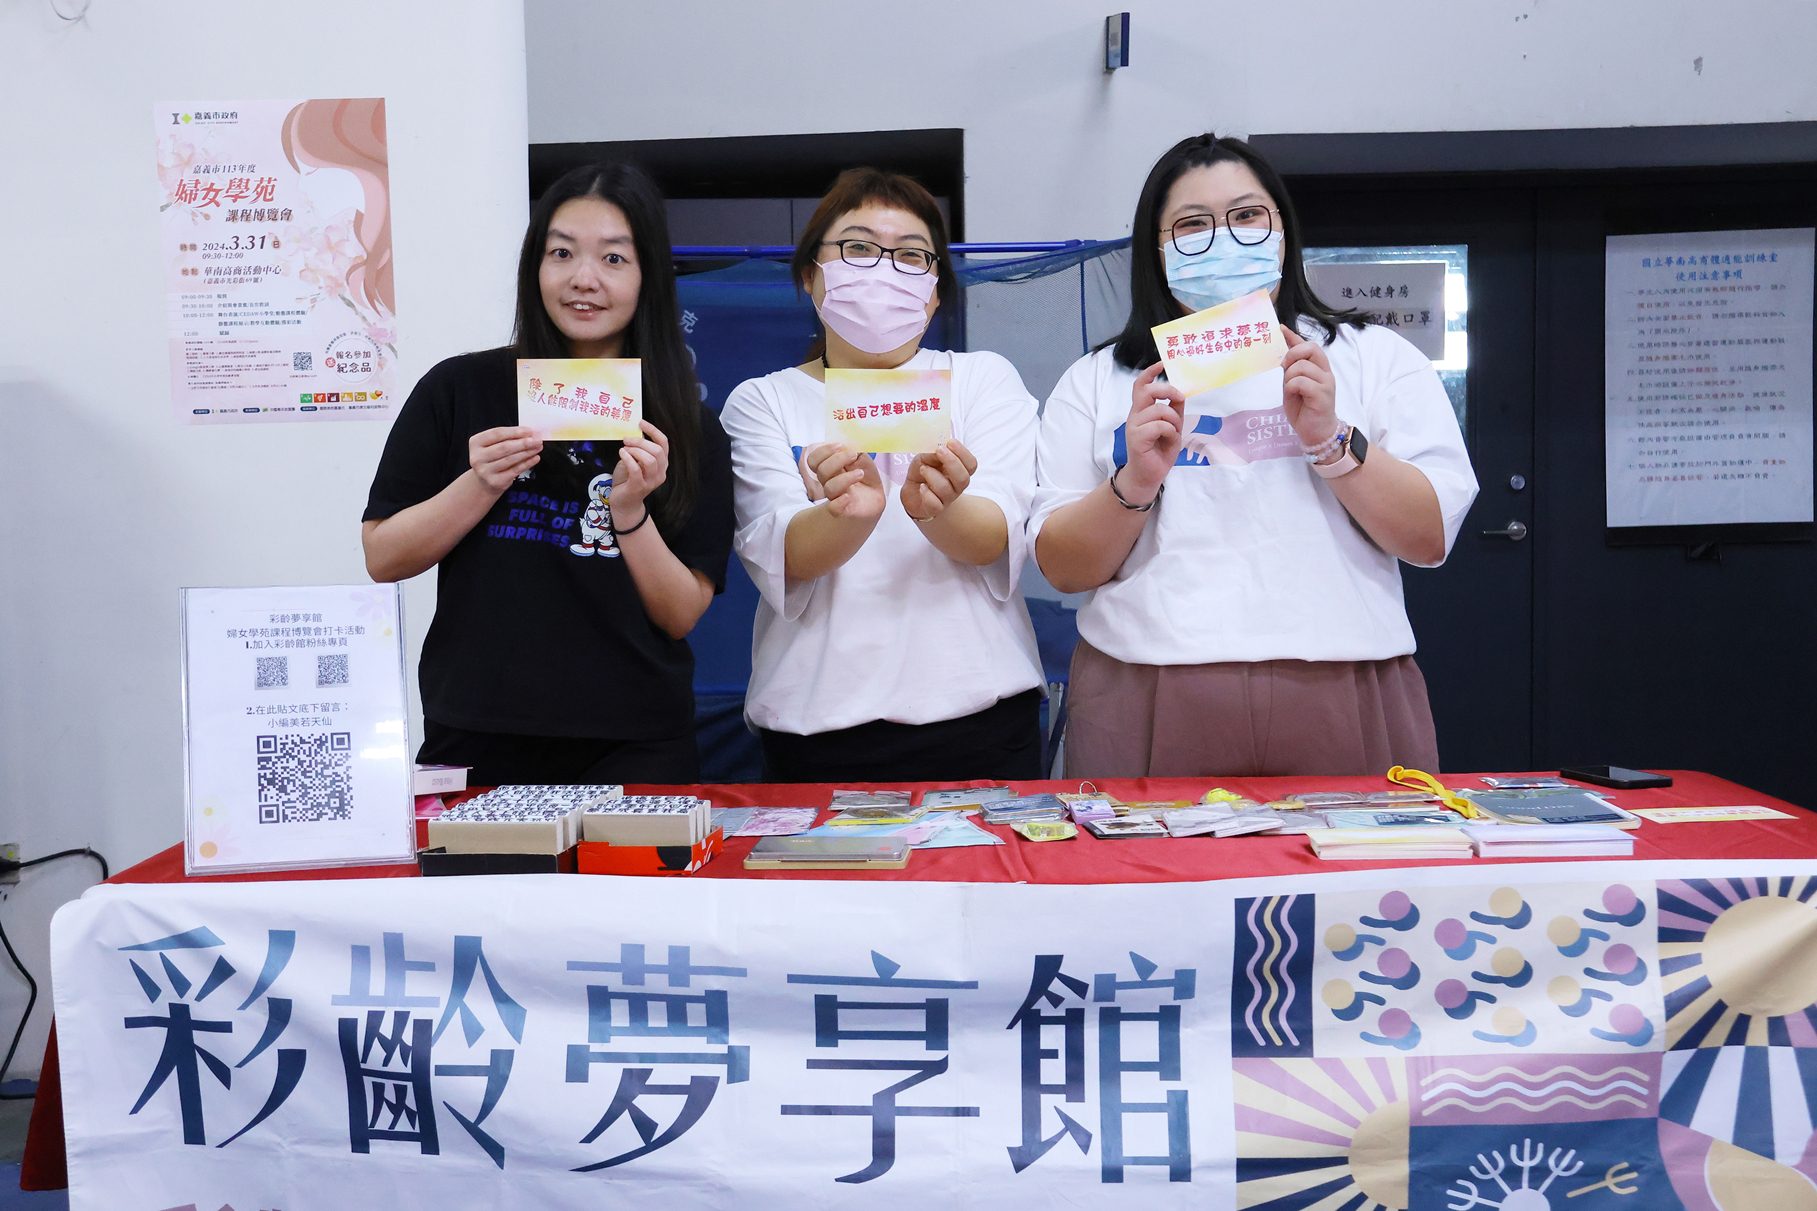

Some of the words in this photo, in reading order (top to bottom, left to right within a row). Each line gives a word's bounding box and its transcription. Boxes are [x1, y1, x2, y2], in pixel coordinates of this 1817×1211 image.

[194, 111, 238, 121] 嘉義市政府
[193, 164, 256, 175] 嘉義市113年度
[174, 177, 278, 208] 婦女學苑
[225, 209, 293, 222] 課程博覽會
[202, 235, 266, 251] 2024.3.31
[204, 265, 282, 276] 華南高商活動中心
[1675, 270, 1743, 283] 使用注意事項
[1341, 285, 1408, 299] 進入健身房
[336, 350, 372, 360] 報名參加
[336, 362, 372, 374] 紀念品
[833, 397, 941, 421] 活出自己想要的溫度
[508, 491, 559, 511] SPACE
[562, 500, 580, 514] IS
[508, 508, 547, 526] FULL
[551, 516, 575, 530] OF
[487, 524, 570, 548] SURPRISES
[268, 613, 323, 624] 彩齡夢享館
[226, 625, 366, 639] 婦女學苑課程博覽會打卡活動
[245, 637, 348, 650] 1.加入彩齡館粉絲專頁
[268, 716, 333, 729] 小編美若天仙
[117, 925, 1197, 1186] 彩齡夢享館
